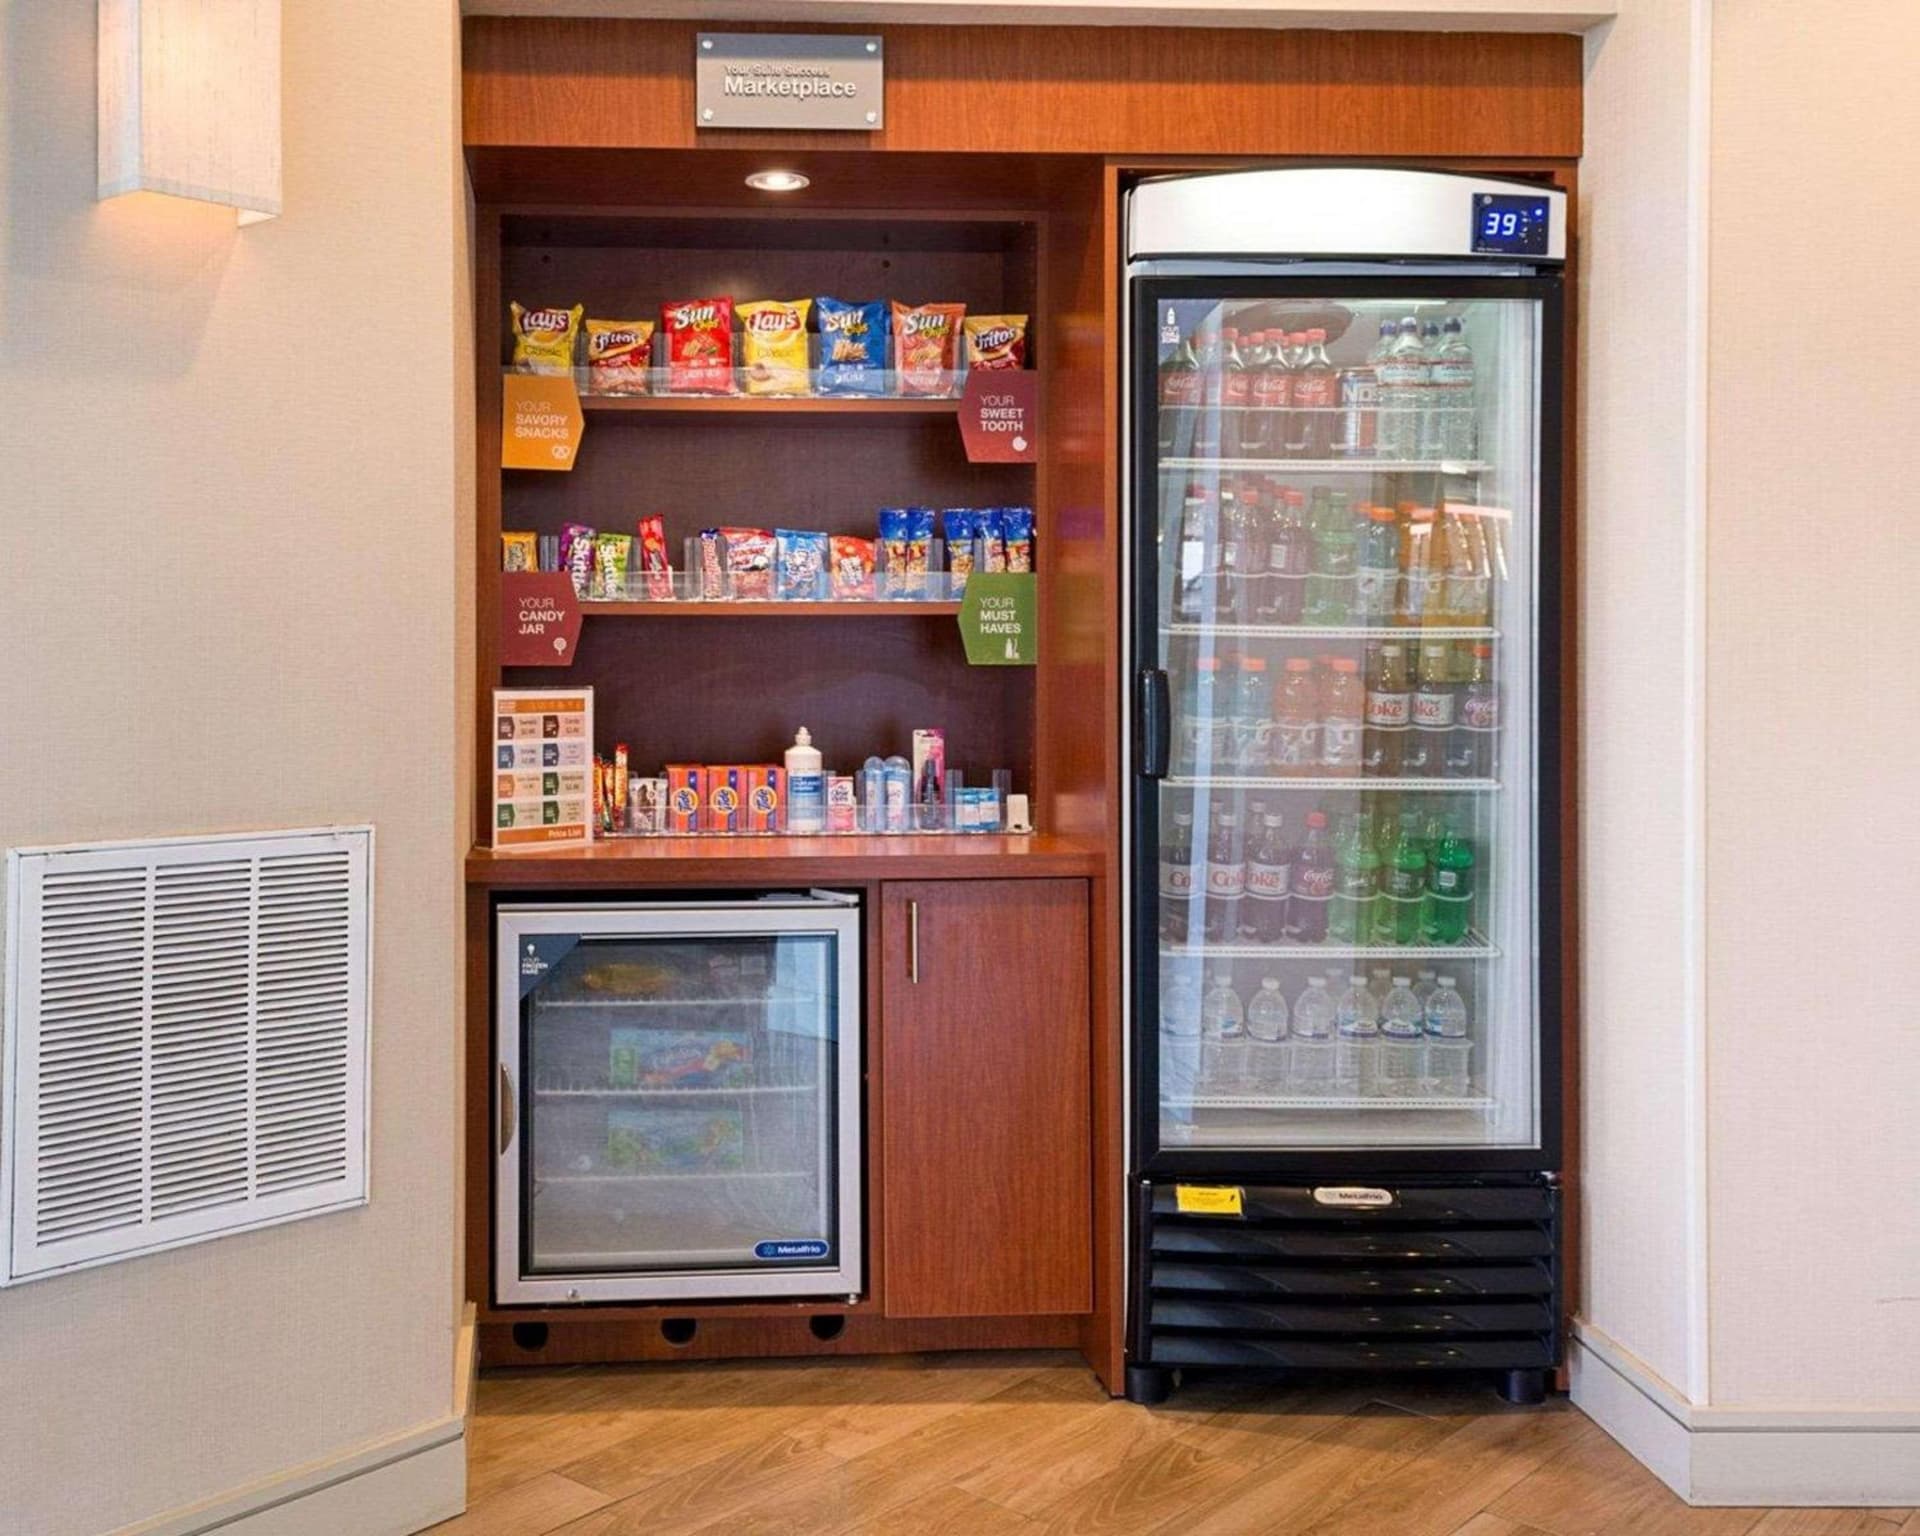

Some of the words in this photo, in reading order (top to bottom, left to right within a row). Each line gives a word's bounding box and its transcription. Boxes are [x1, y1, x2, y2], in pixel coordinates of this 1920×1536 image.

[724, 76, 857, 100] Marketplace
[1485, 213, 1517, 235] 39
[674, 305, 714, 329] Sun
[825, 310, 864, 332] Sun
[903, 312, 944, 335] Sun
[977, 328, 1016, 350] Fritos
[980, 395, 1014, 406] YOUR
[516, 401, 551, 412] YOUR
[980, 408, 1024, 419] SWEET
[516, 414, 568, 425] SAVORY
[980, 421, 1024, 432] TOOTH
[516, 427, 568, 438] SNACKS
[519, 598, 554, 608] YOUR
[980, 598, 1014, 608] YOUR
[519, 611, 565, 622] CANDY
[980, 610, 1016, 620] MUST
[519, 624, 545, 634] JAR
[980, 623, 1021, 634] HAVES
[777, 1246, 821, 1255] Metalfrio
